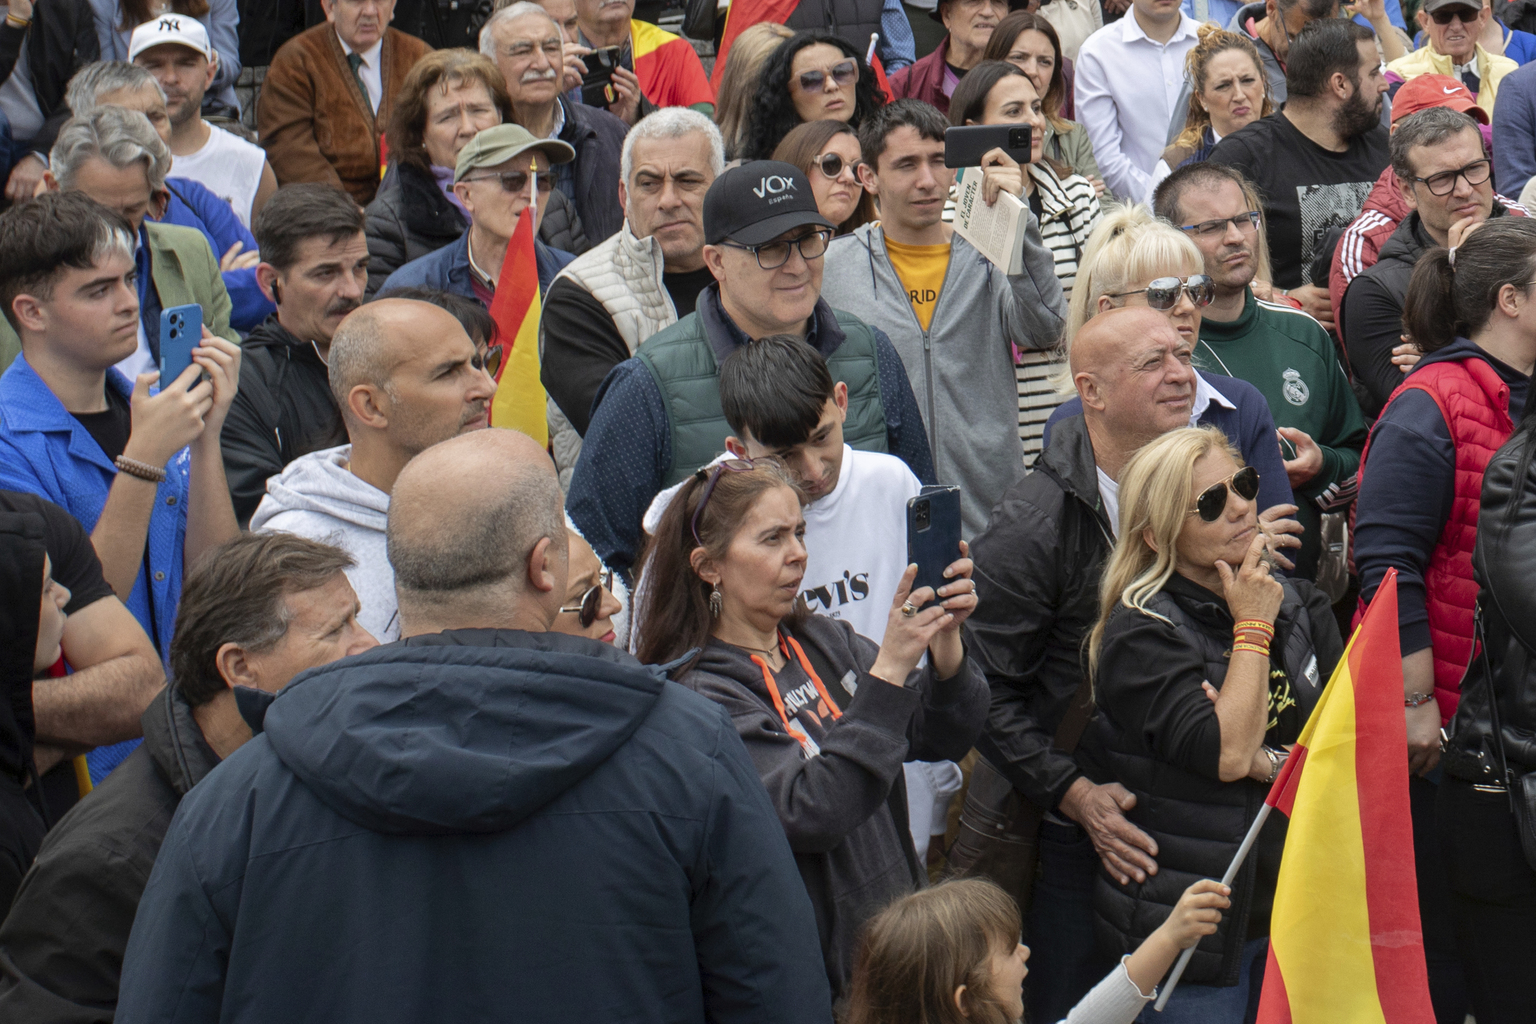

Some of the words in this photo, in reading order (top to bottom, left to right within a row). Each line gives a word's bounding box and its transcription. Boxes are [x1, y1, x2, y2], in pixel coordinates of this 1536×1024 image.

[752, 175, 798, 199] VOX
[962, 183, 972, 209] JOVEN
[907, 289, 936, 304] RID
[803, 569, 869, 616] evi's
